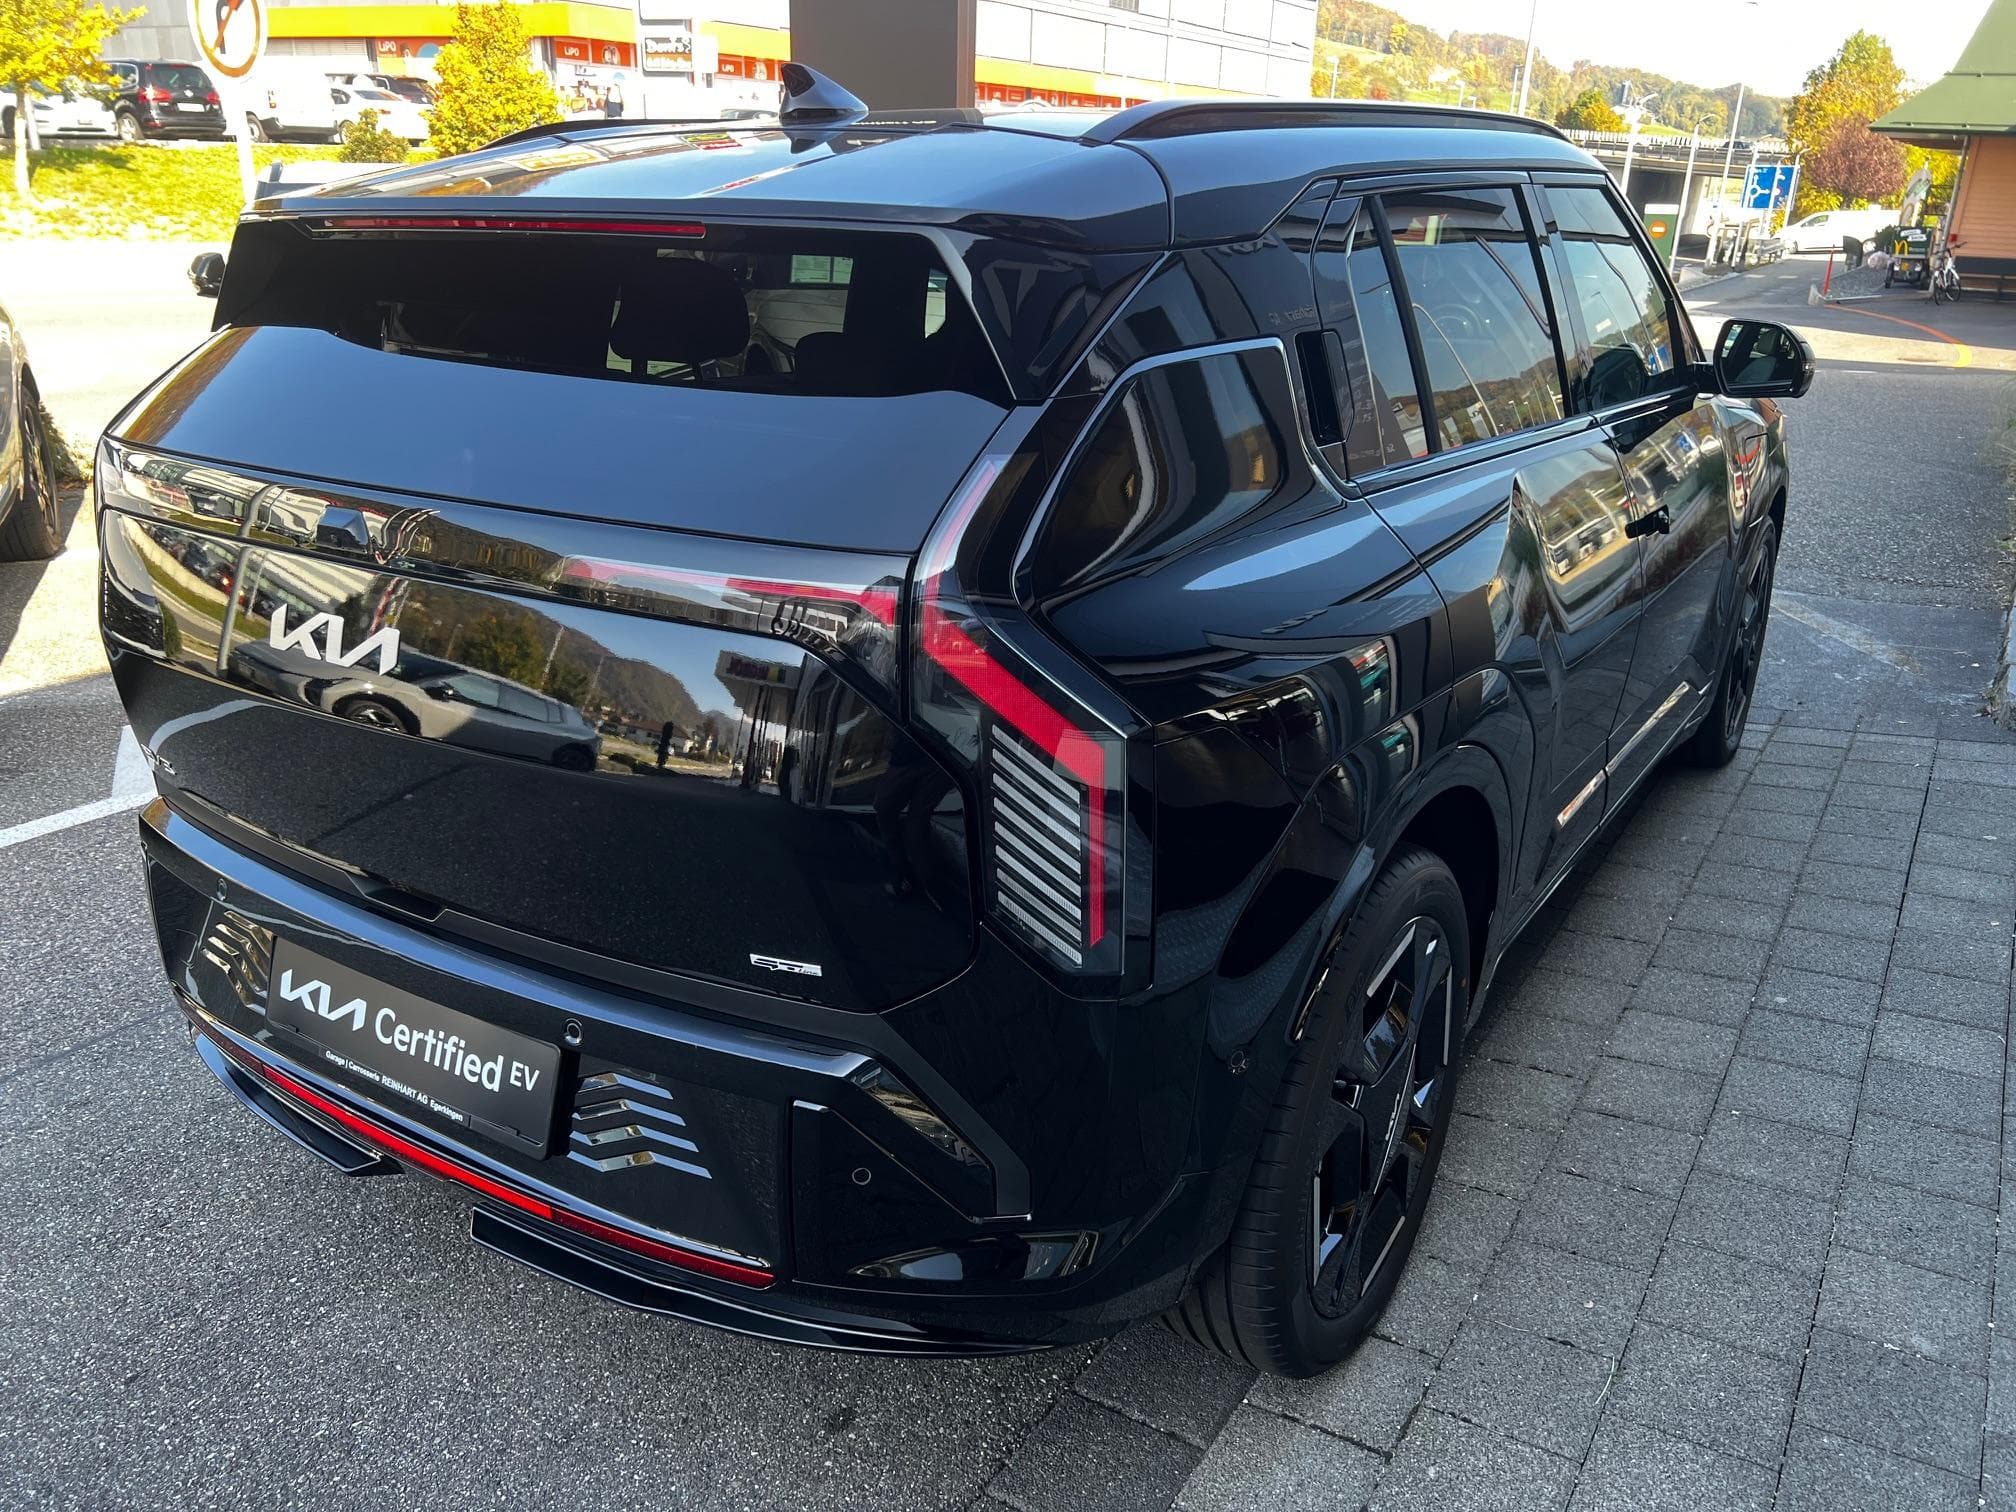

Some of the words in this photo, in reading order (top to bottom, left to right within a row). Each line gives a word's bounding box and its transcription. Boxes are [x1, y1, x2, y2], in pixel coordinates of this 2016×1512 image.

[270, 603, 400, 676] KIA
[280, 969, 367, 1032] KIA
[375, 1007, 504, 1093] Certified
[510, 1060, 540, 1091] EV
[325, 1050, 346, 1066] Garage
[348, 1061, 381, 1082] Carrosserie
[381, 1075, 416, 1099] REINHART
[416, 1092, 429, 1105] AG
[429, 1099, 464, 1122] Egerkingen
